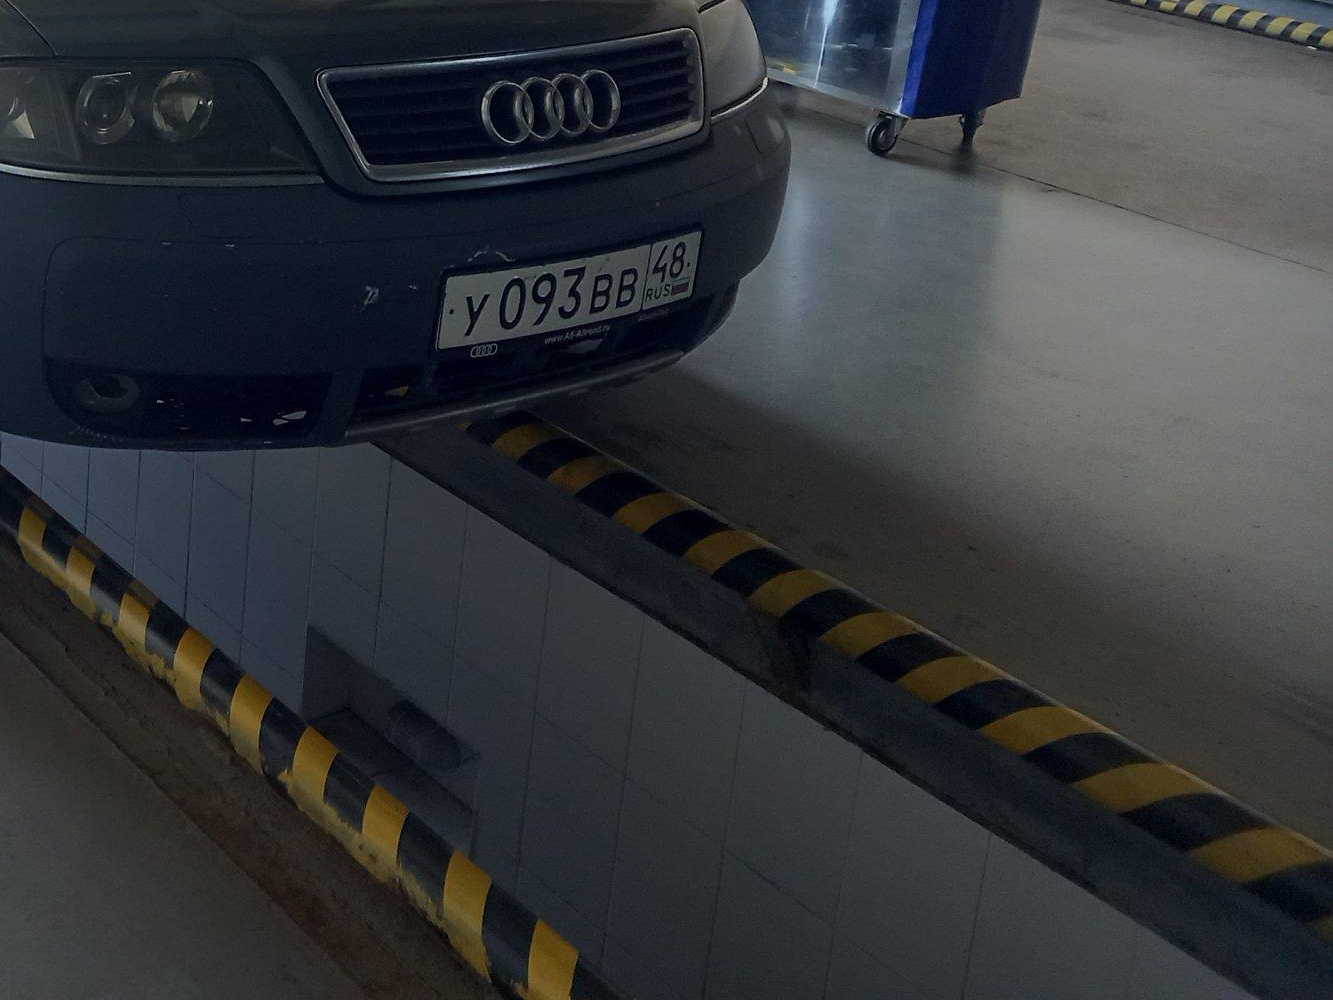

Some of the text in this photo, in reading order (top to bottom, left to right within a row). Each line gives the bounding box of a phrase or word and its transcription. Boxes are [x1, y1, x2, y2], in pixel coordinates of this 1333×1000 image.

[464, 241, 687, 337] У093ВВ 48
[645, 284, 672, 302] RUS
